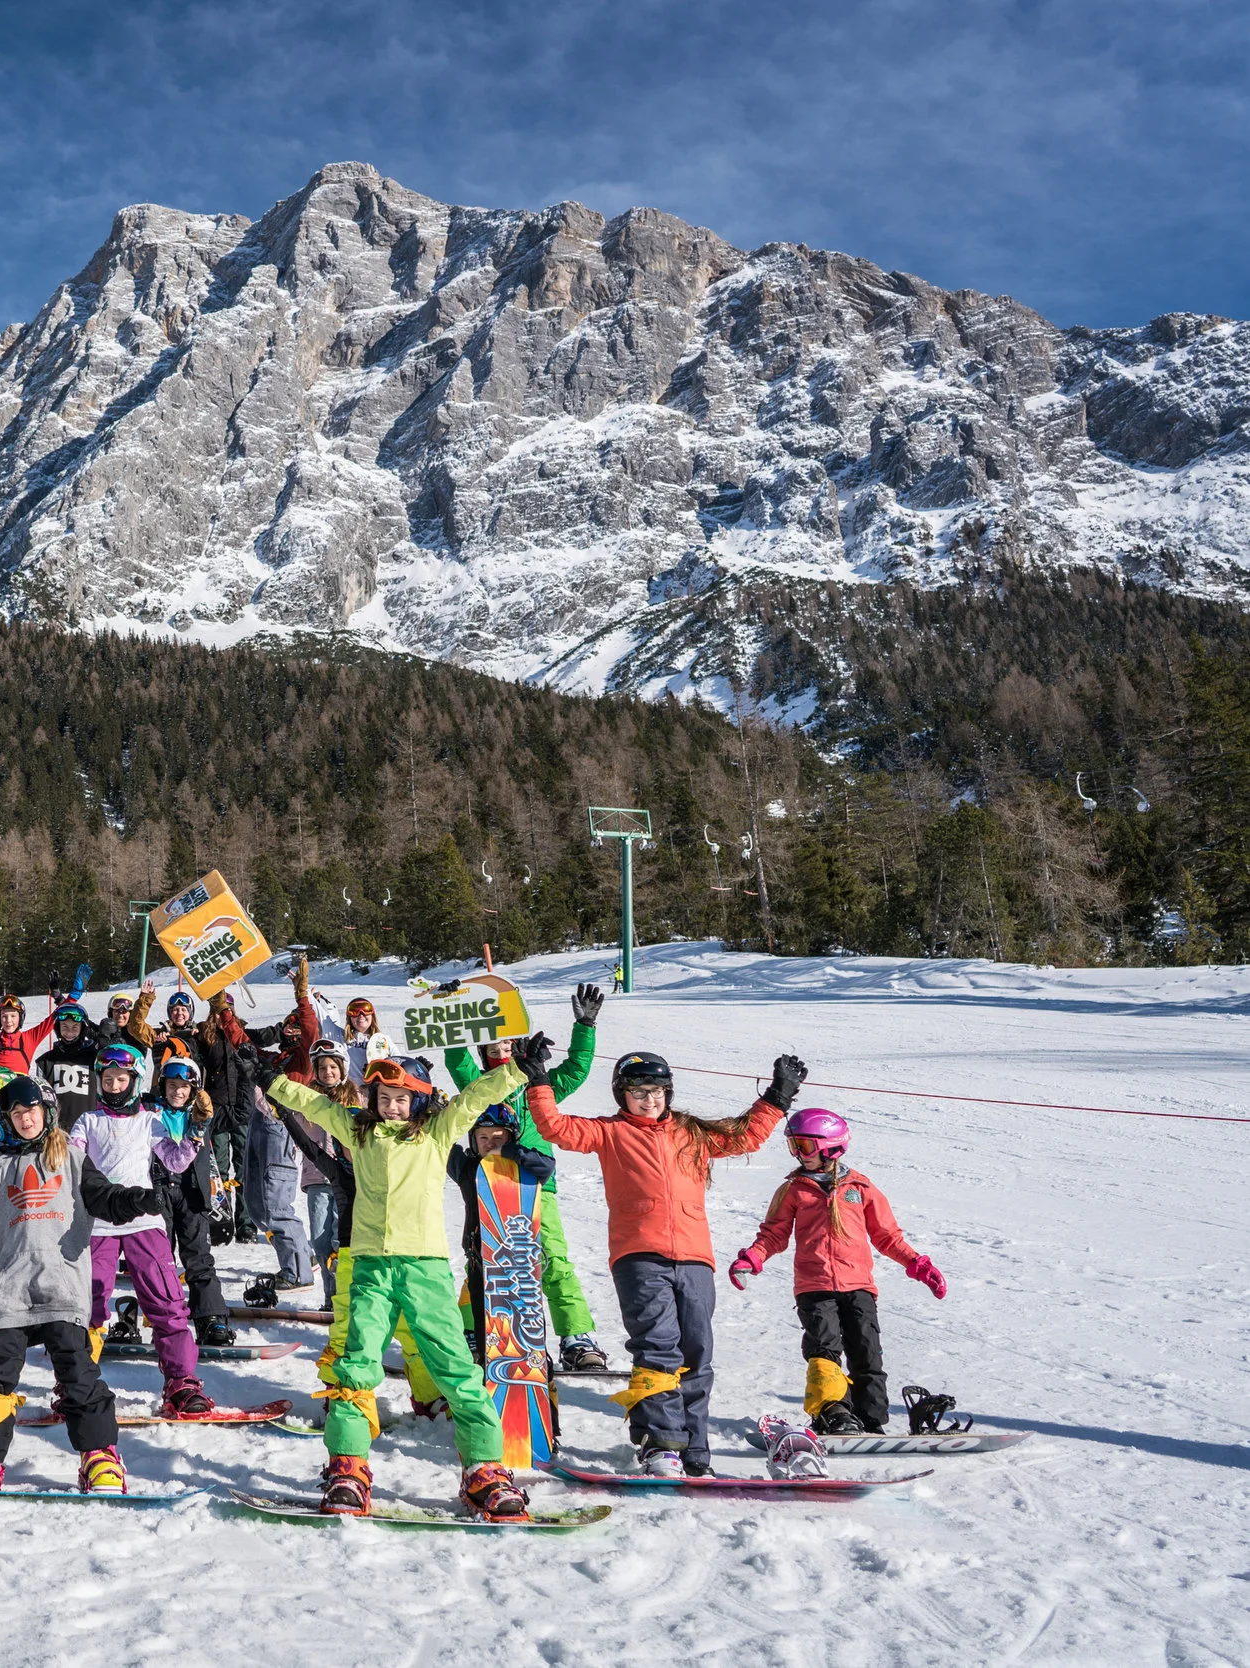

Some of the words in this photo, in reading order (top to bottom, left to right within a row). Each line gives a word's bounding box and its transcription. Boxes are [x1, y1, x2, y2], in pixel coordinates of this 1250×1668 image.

[183, 931, 237, 970] SPRUNG
[188, 939, 243, 985] BRETT
[404, 997, 502, 1027] SPRUNG
[404, 1015, 507, 1051] BRETT
[53, 1063, 90, 1096] DC
[825, 1437, 981, 1453] NITRO
